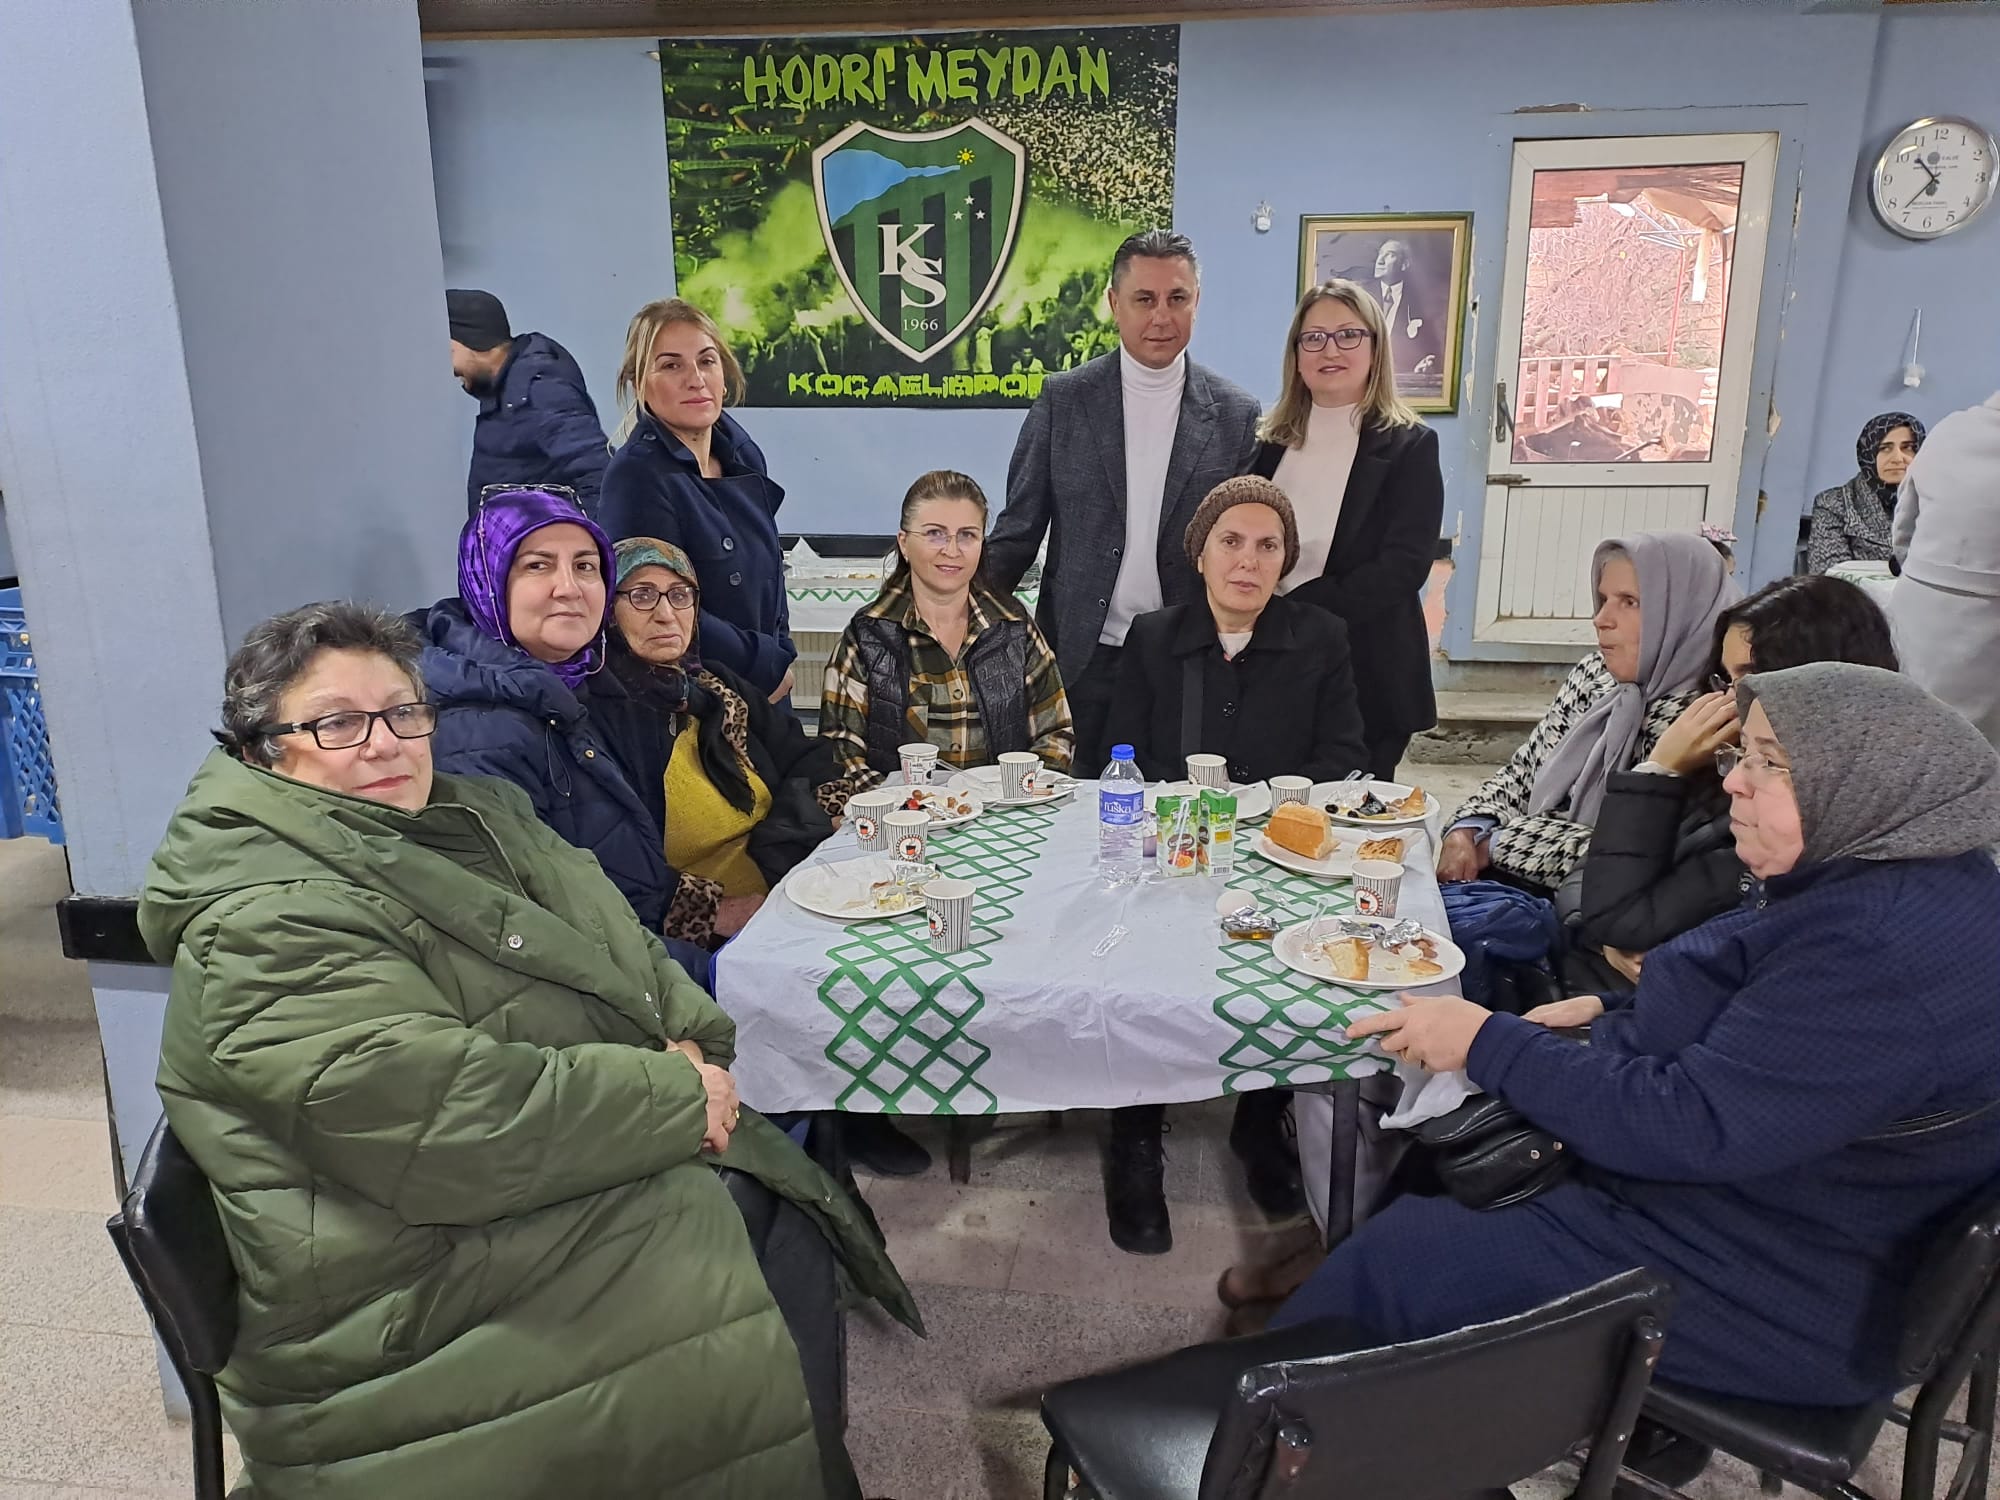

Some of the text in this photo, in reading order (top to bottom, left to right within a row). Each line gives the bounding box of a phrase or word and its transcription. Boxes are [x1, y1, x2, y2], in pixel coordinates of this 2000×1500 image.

[906, 46, 1109, 104] MEYDAN
[1935, 128, 1949, 140] 12
[1972, 149, 1983, 161] 2
[1883, 175, 1893, 186] 9
[1975, 172, 1986, 183] 3
[1887, 198, 1897, 209] 8
[1902, 211, 1911, 223] 7
[1922, 216, 1932, 228] 6
[1946, 211, 1955, 222] 5
[903, 319, 939, 331] 1966
